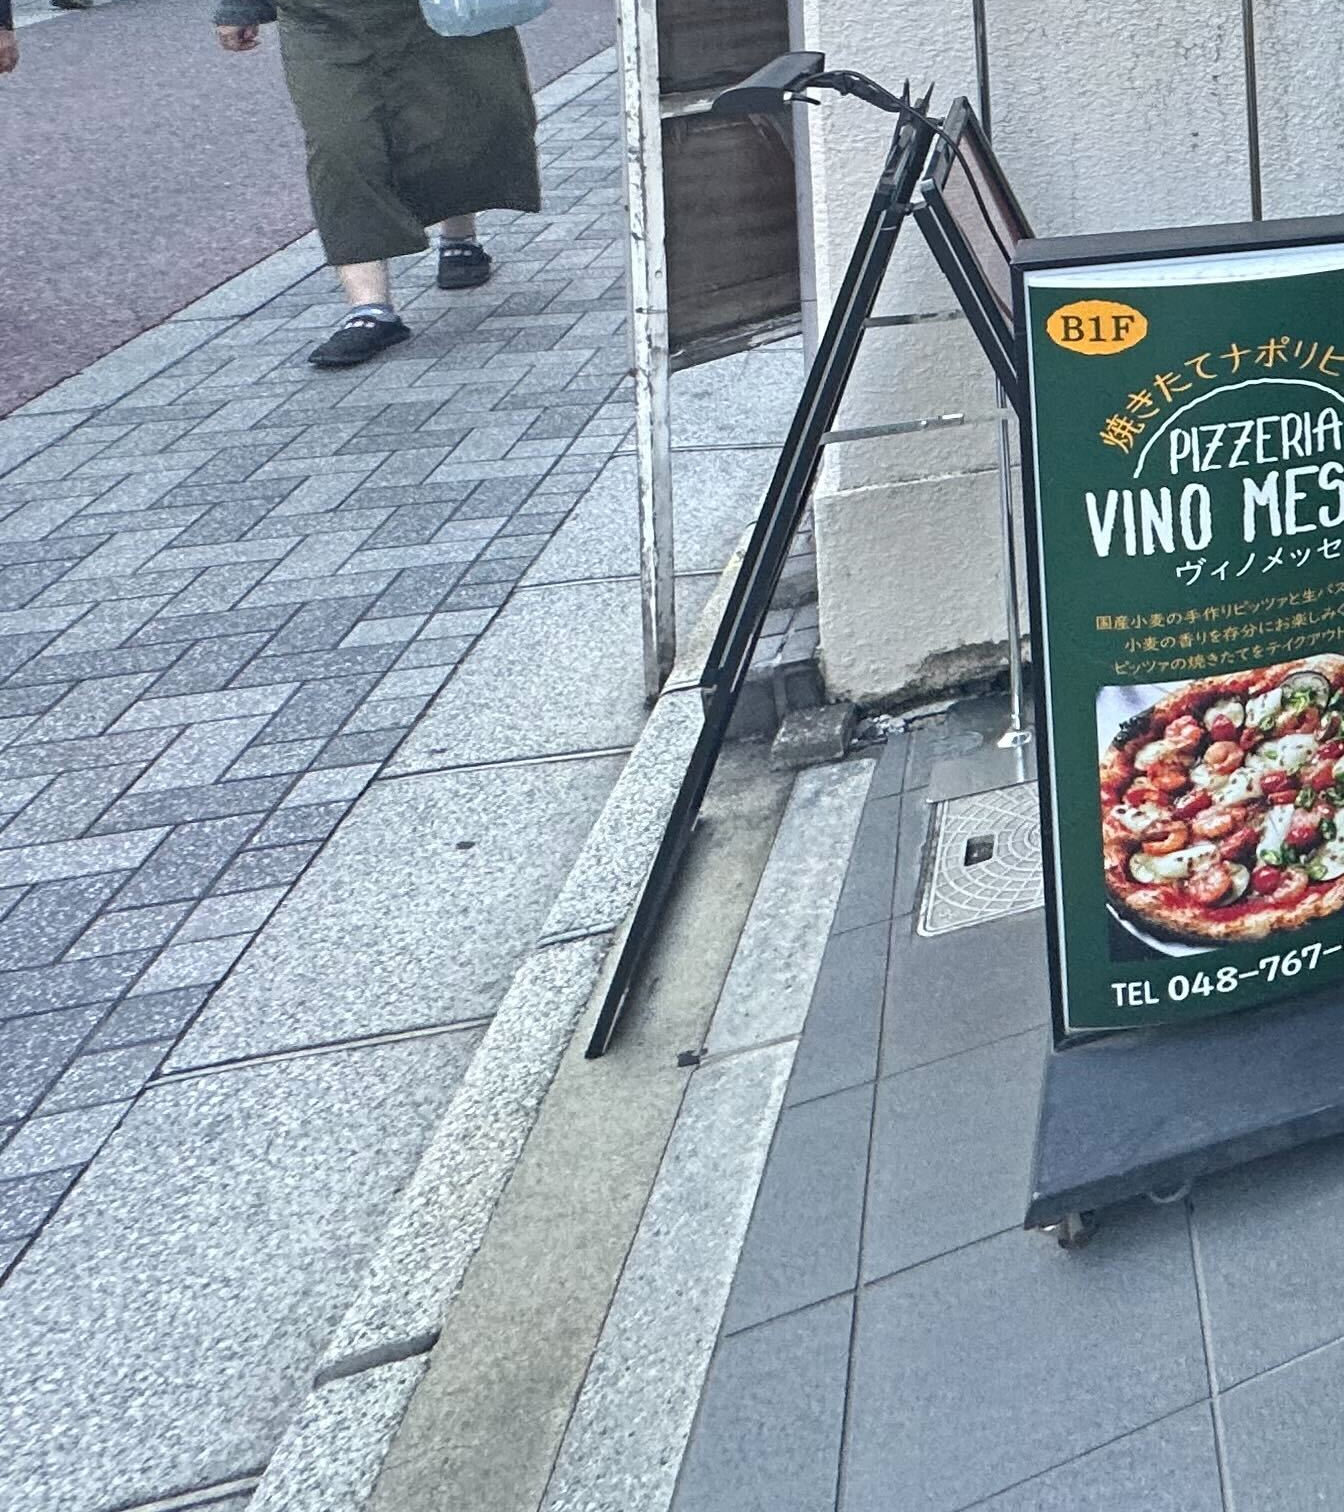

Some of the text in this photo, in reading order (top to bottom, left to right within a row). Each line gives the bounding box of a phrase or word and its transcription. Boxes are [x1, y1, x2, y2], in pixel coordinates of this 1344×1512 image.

[1060, 315, 1135, 342] B1F
[1170, 407, 1343, 474] PIZZERIA
[1085, 482, 1212, 557] VINO
[1176, 537, 1342, 585] ヴィノメッセ
[1112, 980, 1159, 1007] TEL
